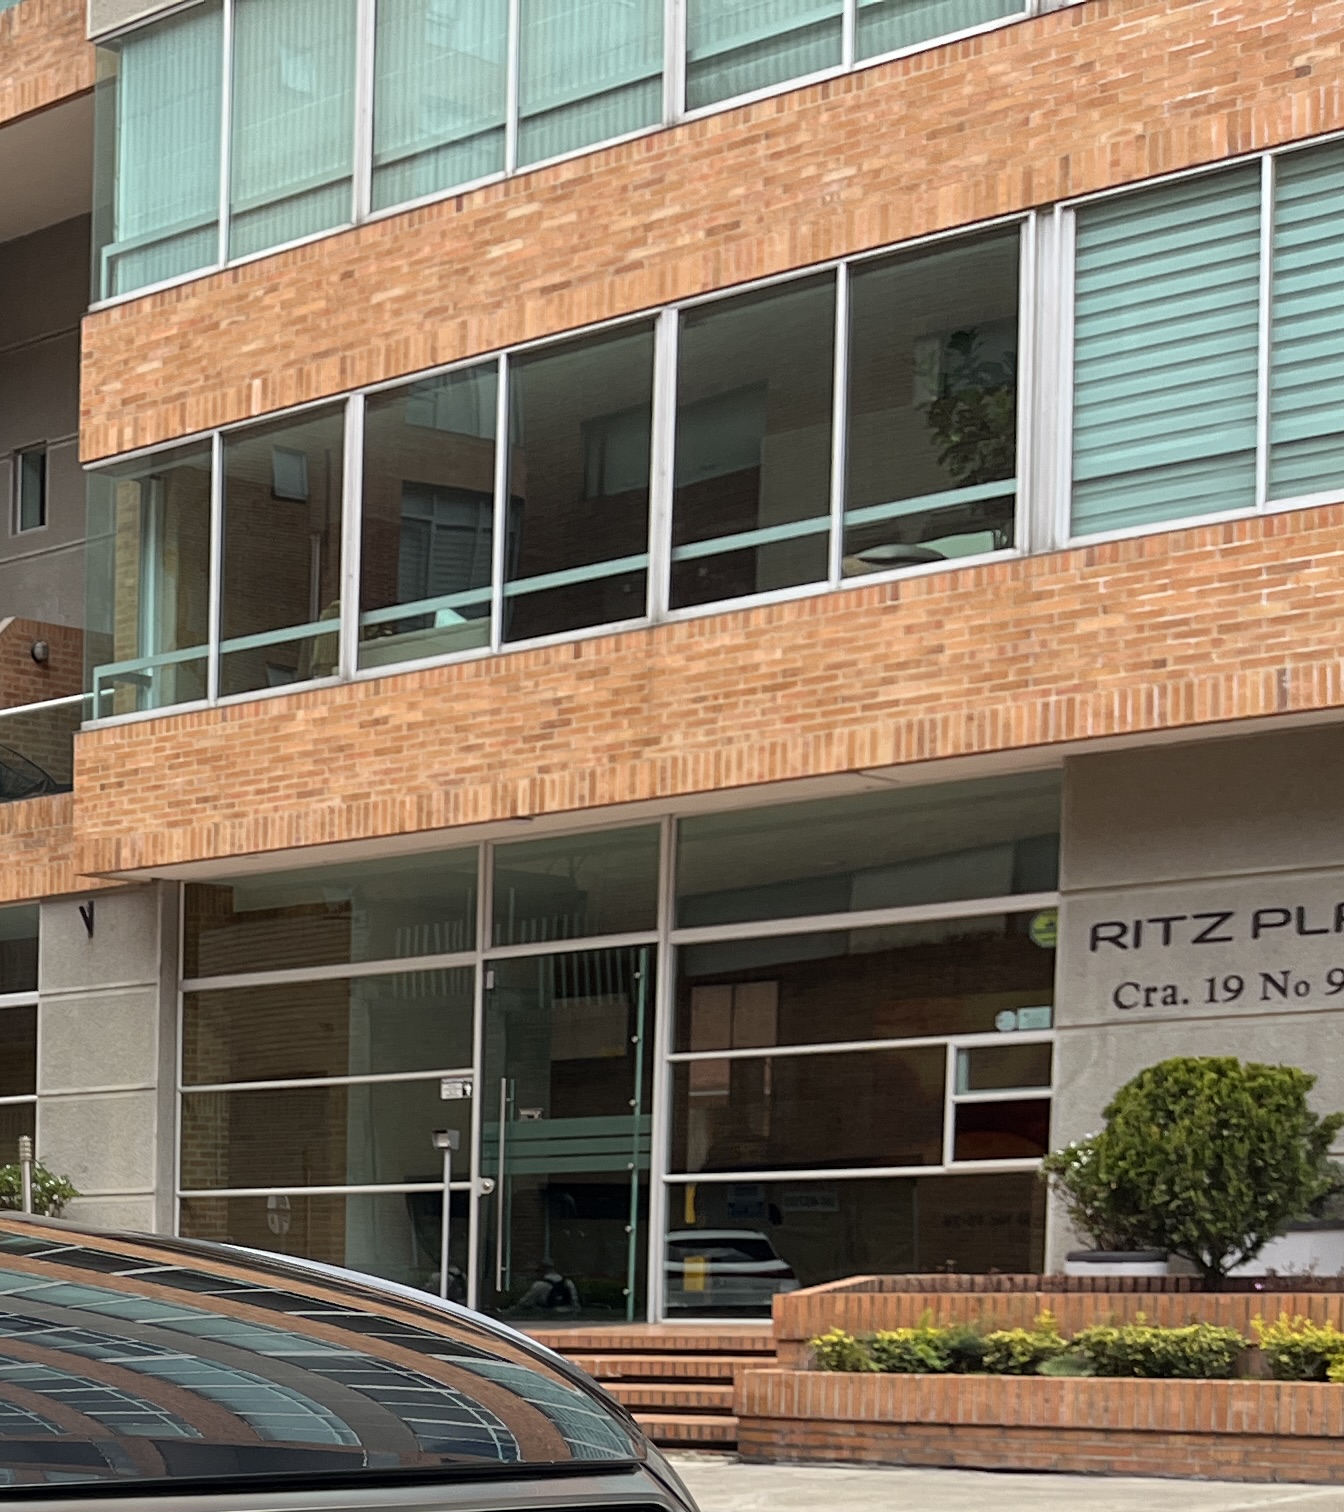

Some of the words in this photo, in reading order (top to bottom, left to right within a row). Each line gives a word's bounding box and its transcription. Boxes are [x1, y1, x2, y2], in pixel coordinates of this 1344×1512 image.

[1089, 911, 1235, 952] RITZ
[1113, 981, 1189, 1010] Cra.
[1204, 974, 1245, 1005] 19
[1259, 969, 1311, 1001] No
